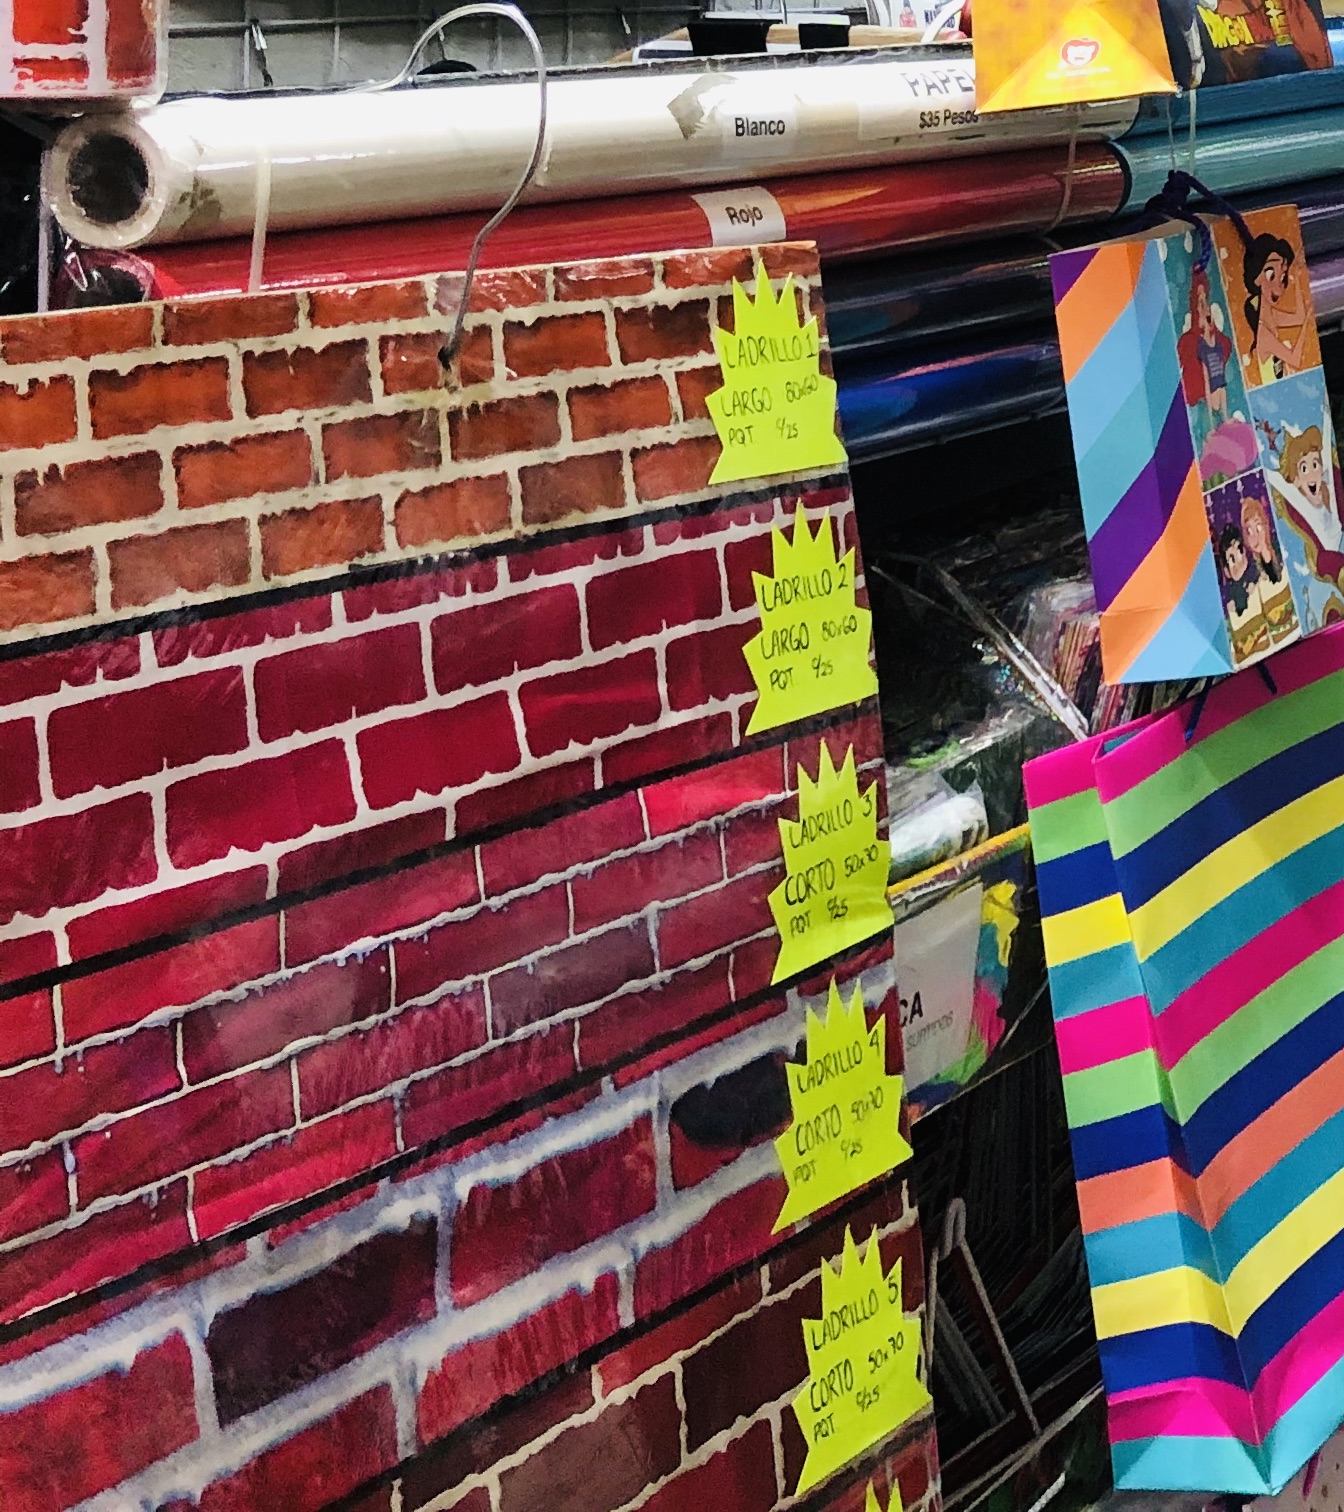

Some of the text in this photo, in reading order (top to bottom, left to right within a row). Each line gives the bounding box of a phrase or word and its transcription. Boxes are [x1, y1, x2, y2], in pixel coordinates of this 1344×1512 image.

[734, 116, 786, 138] Blanco
[918, 103, 979, 129] $35 Pesos
[725, 204, 764, 227] Rojo
[724, 335, 802, 369] LADRILLO
[721, 386, 773, 418] LARGO
[762, 563, 849, 613] LADRILLO 2
[760, 622, 810, 660] LARGO
[788, 793, 873, 849] LADRILLO 3
[784, 857, 836, 907] CORTO
[796, 1040, 863, 1094] LADRILLO
[795, 1103, 841, 1157] CORTO
[811, 1274, 899, 1352] LADRILLO 5
[809, 1358, 855, 1414] CORTO
